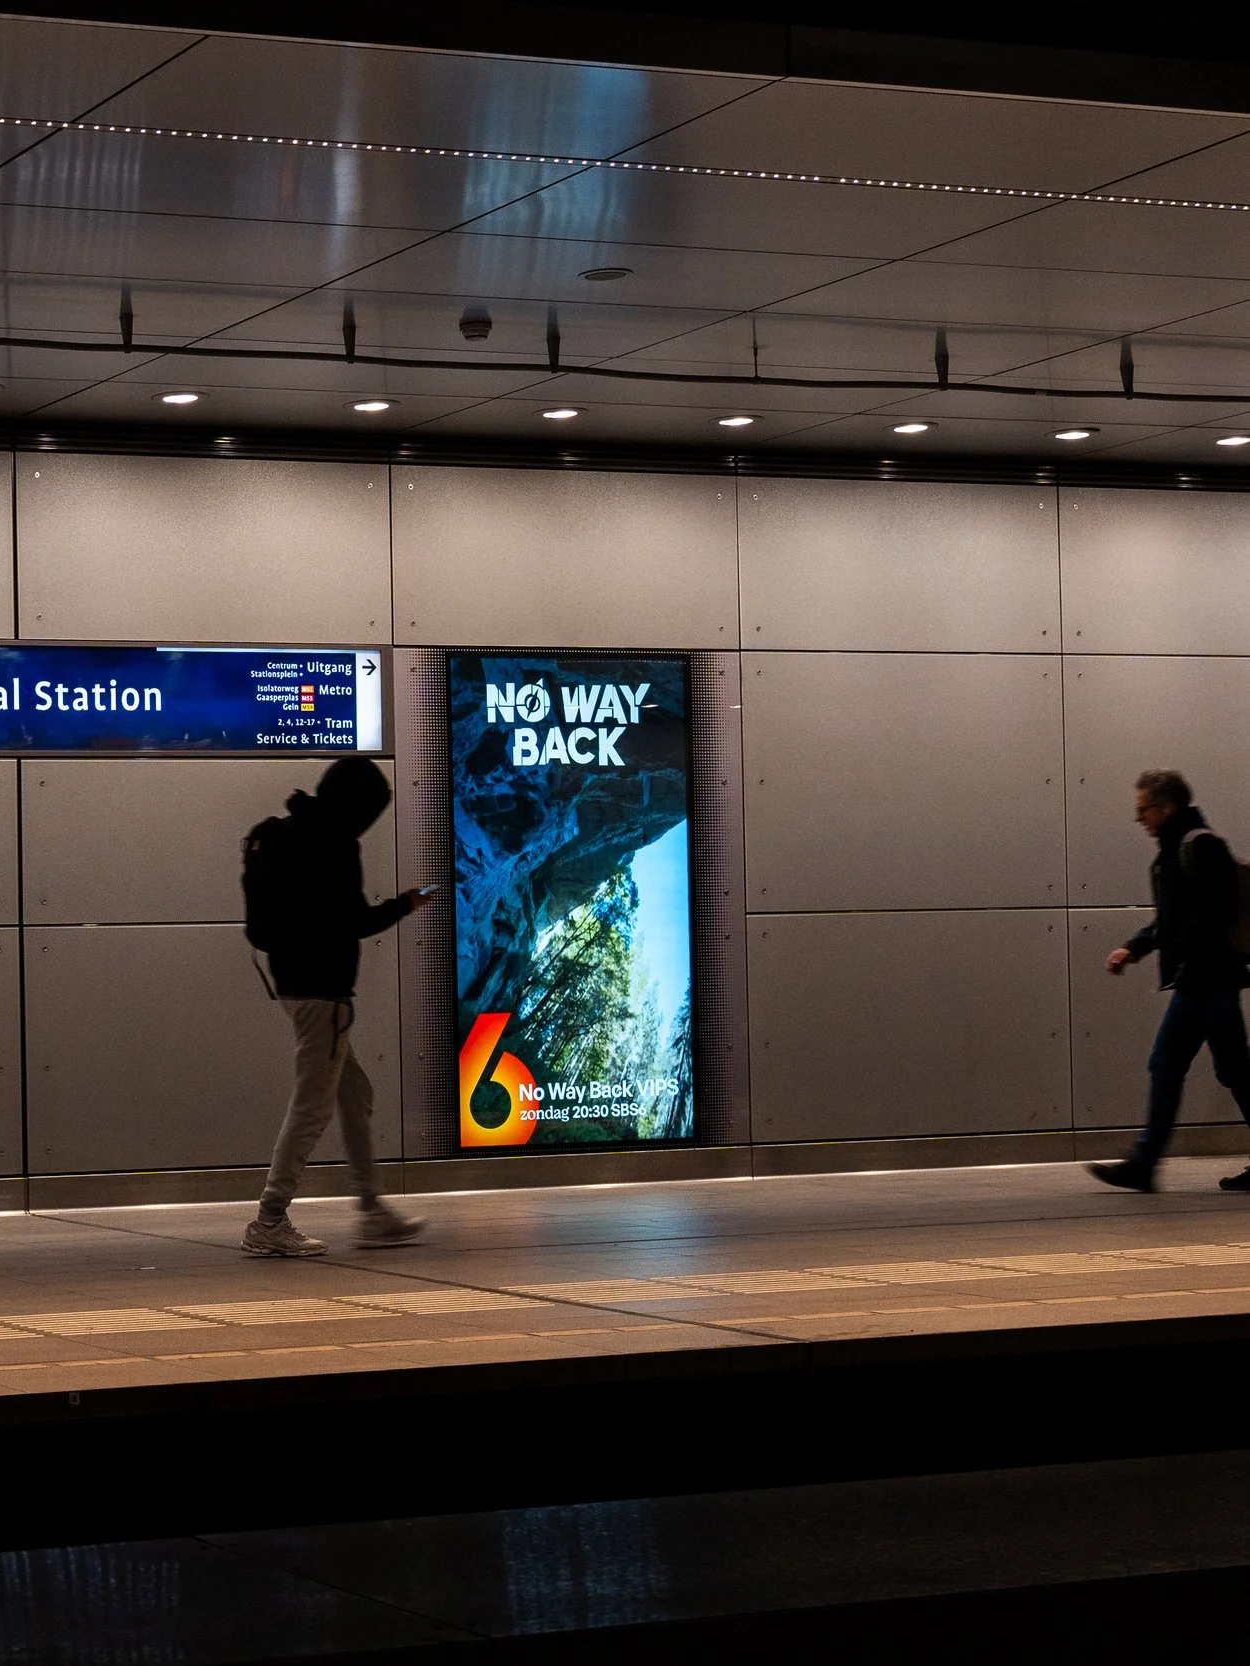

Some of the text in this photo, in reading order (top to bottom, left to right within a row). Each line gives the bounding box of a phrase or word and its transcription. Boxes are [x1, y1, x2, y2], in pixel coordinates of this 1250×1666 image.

[250, 670, 298, 679] Stationsplein
[267, 661, 352, 676] Centrum Uitgang
[35, 679, 163, 712] Station
[257, 684, 299, 694] Isolatorweg
[319, 684, 353, 695] Metro
[256, 693, 299, 703] Gaasperplas
[486, 678, 651, 725] NO WAY
[282, 702, 299, 711] Gein
[277, 717, 353, 729] 2, 4, 12-17 Tram
[256, 732, 353, 744] Service & Tickets
[512, 726, 627, 766] BACK
[518, 1078, 679, 1103] No Way Back VIPS
[520, 1103, 647, 1122] zondag 20:30 SBS6
